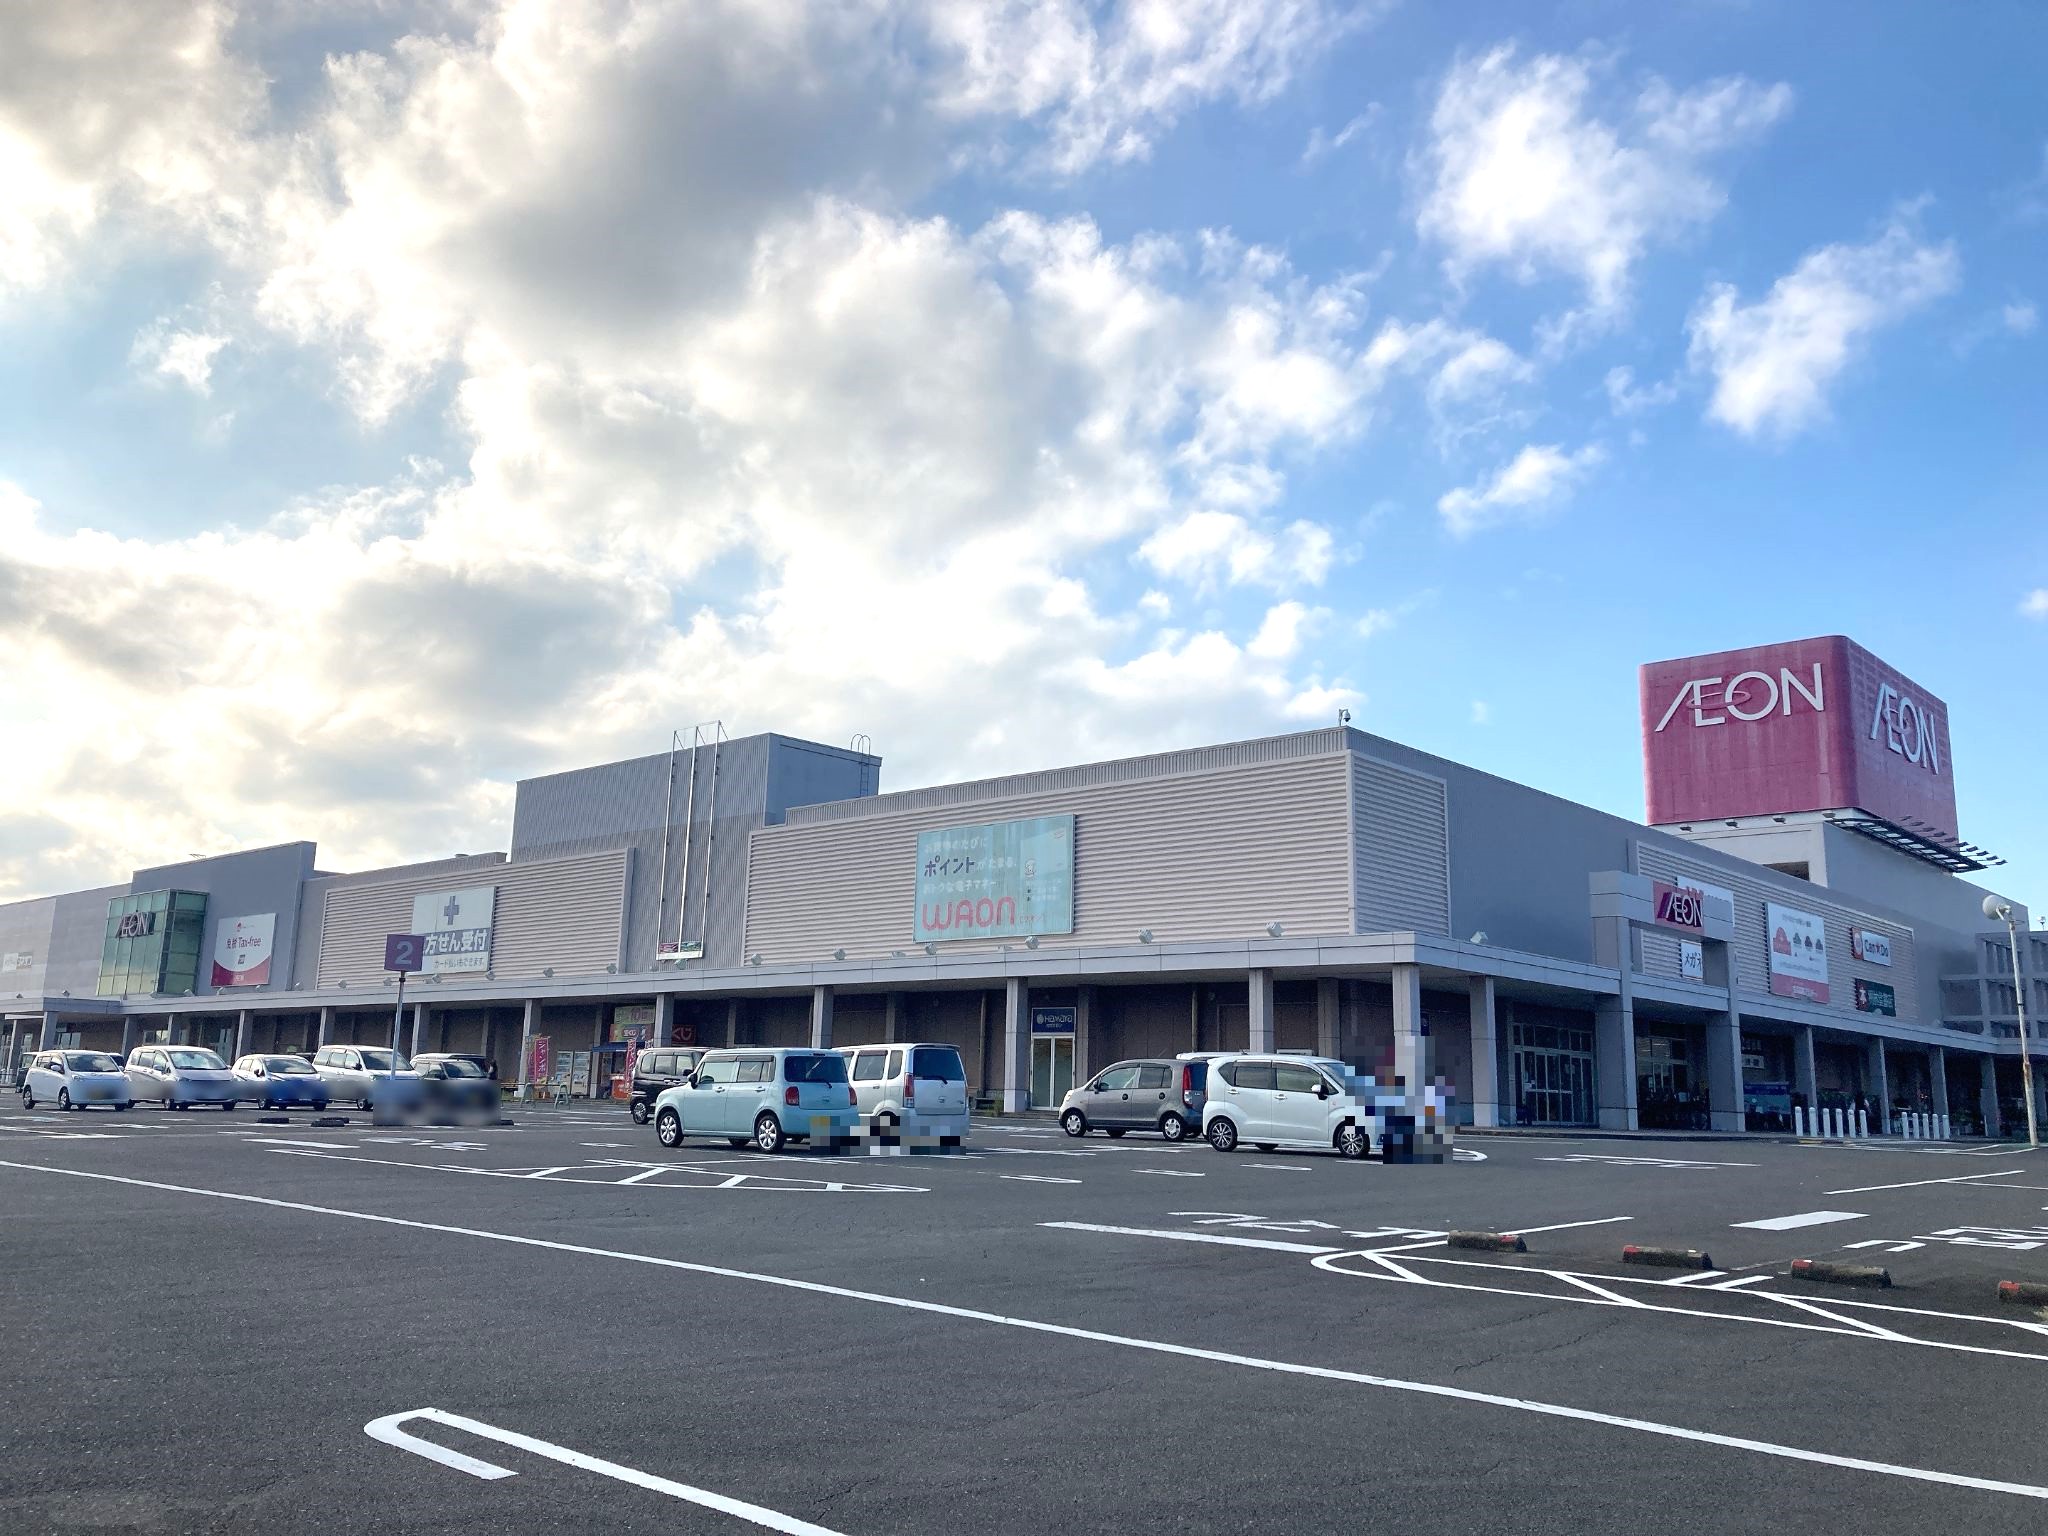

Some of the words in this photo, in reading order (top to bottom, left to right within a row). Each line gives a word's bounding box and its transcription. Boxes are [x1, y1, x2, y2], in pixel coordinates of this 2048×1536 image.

[922, 896, 1016, 931] WAON
[394, 941, 413, 965] 2
[424, 929, 487, 955] 方せん受付
[672, 1026, 693, 1041] くじ
